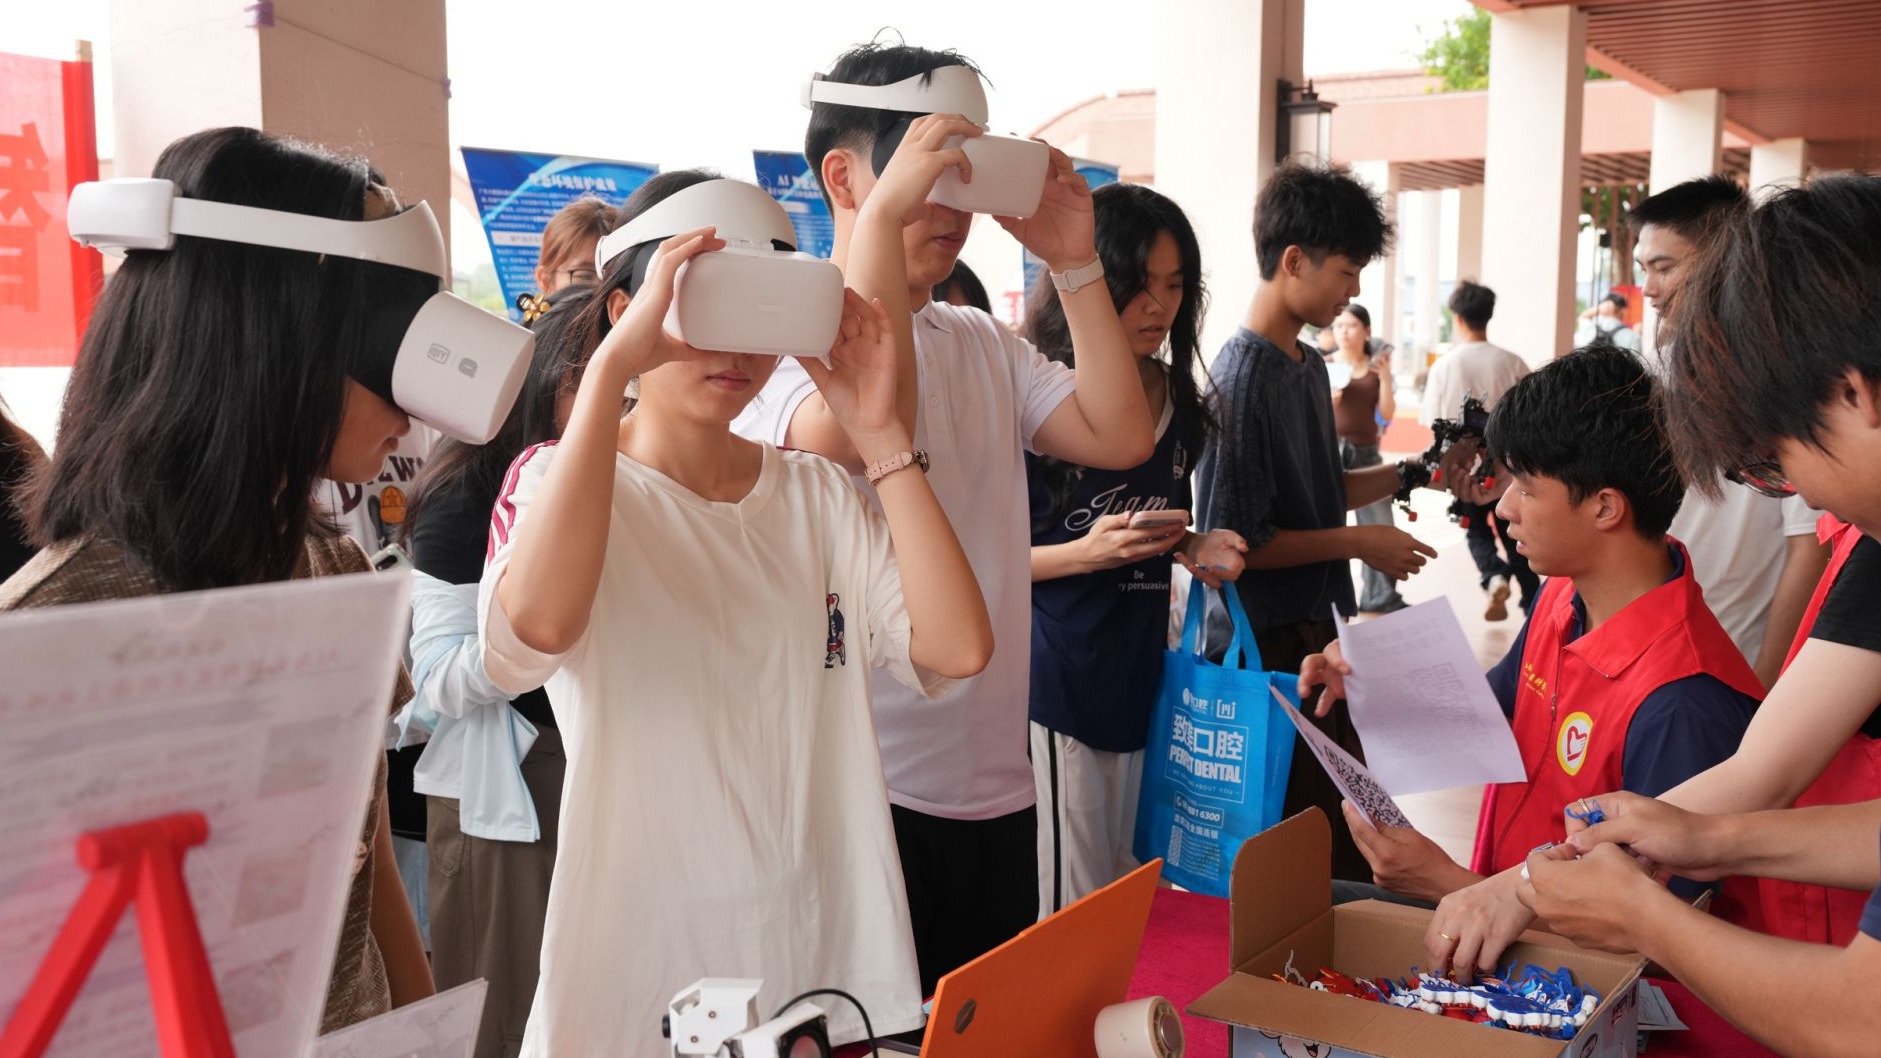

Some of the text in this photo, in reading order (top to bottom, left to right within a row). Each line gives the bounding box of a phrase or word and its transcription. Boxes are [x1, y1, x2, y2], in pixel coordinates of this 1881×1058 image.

[1133, 570, 1145, 580] Be
[1194, 759, 1242, 784] DENTAL
[1199, 810, 1221, 822] 6300
